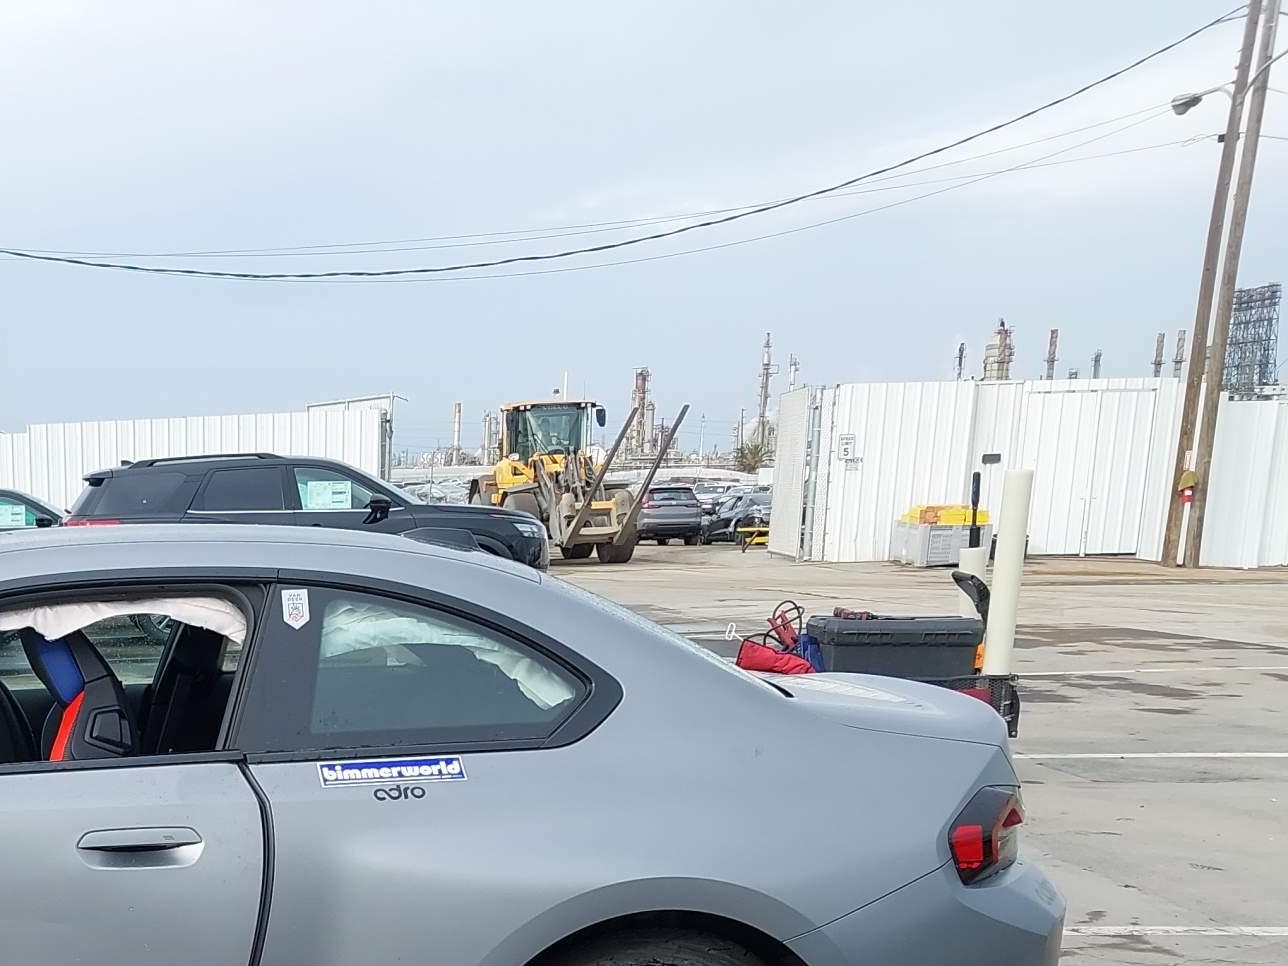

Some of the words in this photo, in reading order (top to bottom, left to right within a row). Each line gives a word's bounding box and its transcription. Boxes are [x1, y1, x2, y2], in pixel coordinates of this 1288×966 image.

[843, 447, 849, 456] 5
[322, 760, 461, 781] bimmerworld
[373, 785, 426, 801] adro
